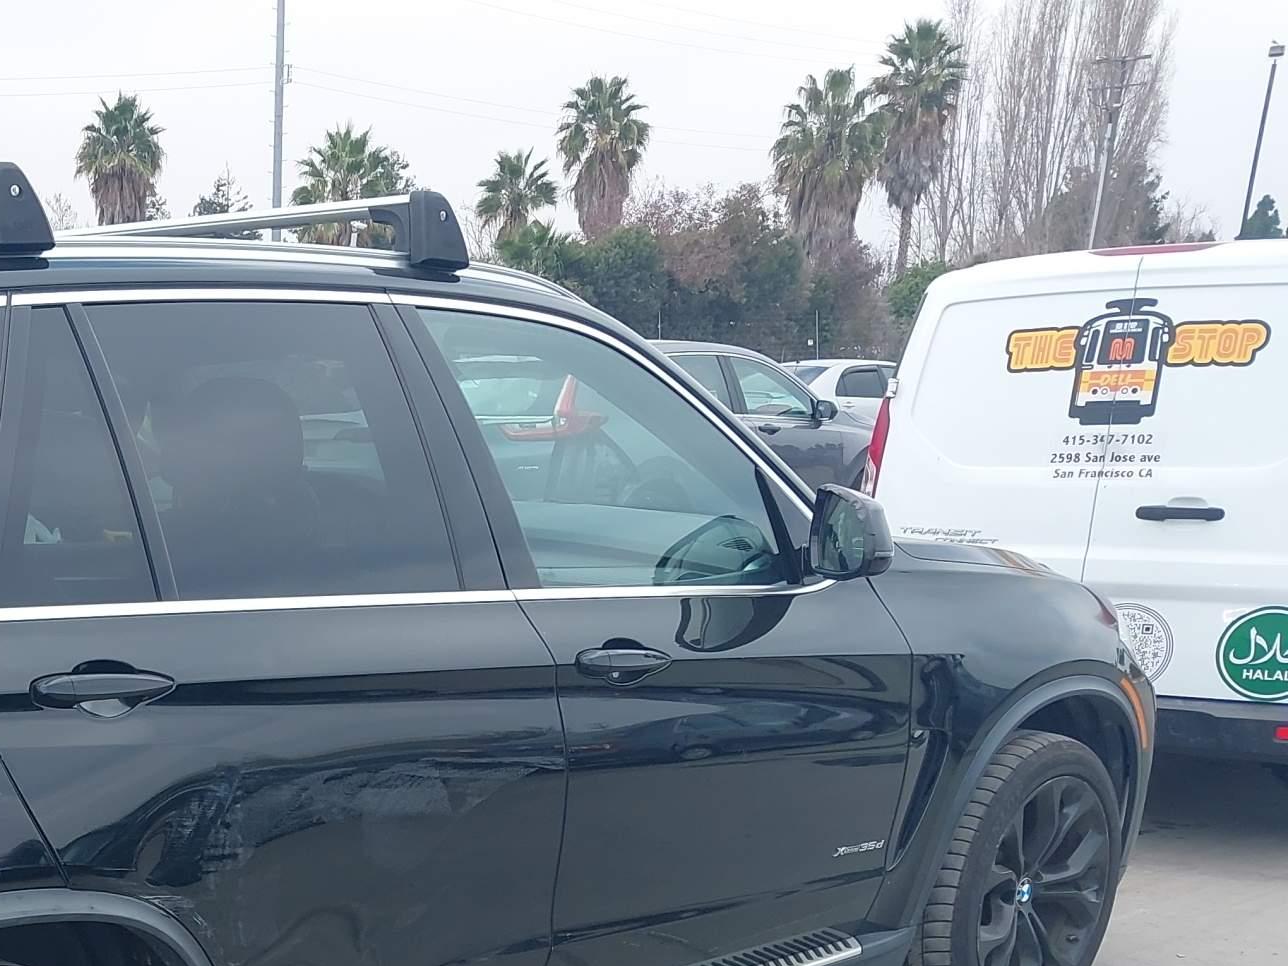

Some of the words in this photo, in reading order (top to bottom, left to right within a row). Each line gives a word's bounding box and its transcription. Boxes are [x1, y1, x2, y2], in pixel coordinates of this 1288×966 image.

[1012, 331, 1078, 368] THE
[1169, 325, 1266, 364] STOP
[1100, 373, 1132, 386] DELI
[1062, 433, 1154, 446] 415-347-7102
[1050, 452, 1081, 463] 2598
[1085, 451, 1105, 462] San
[1110, 451, 1136, 462] Jose
[1140, 454, 1161, 463] ave
[1053, 468, 1074, 478] San
[1078, 467, 1134, 478] Francisco
[1138, 467, 1153, 478] CA
[900, 526, 983, 537] TRANSIT
